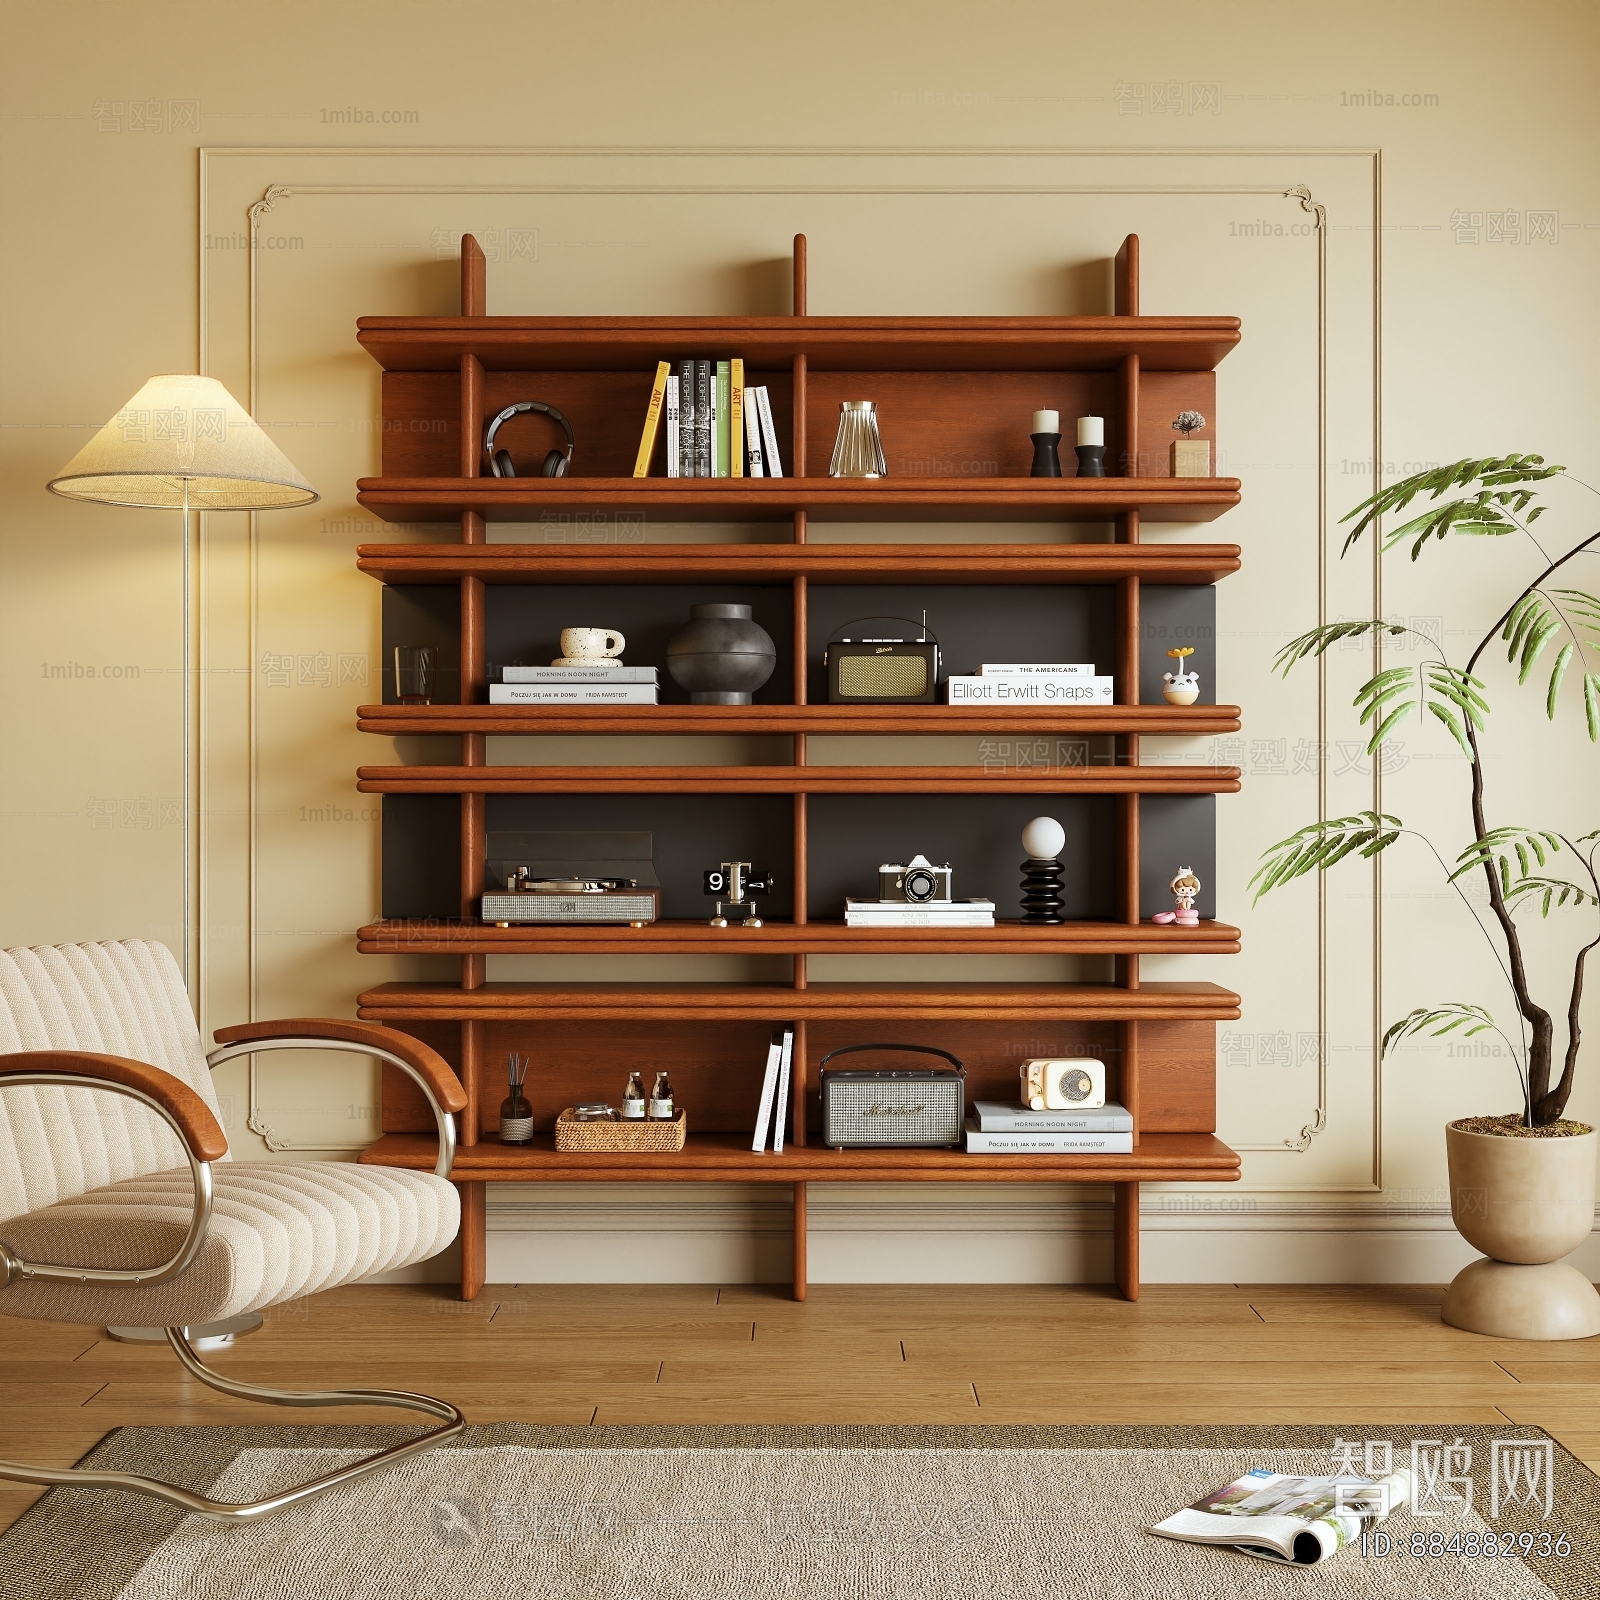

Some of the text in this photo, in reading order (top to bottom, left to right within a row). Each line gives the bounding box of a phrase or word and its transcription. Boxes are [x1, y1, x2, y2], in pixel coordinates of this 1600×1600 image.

[650, 388, 662, 408] ART
[733, 387, 741, 406] ART
[953, 683, 1094, 702] Elliott Erwitt Snaps
[709, 872, 723, 890] 9
